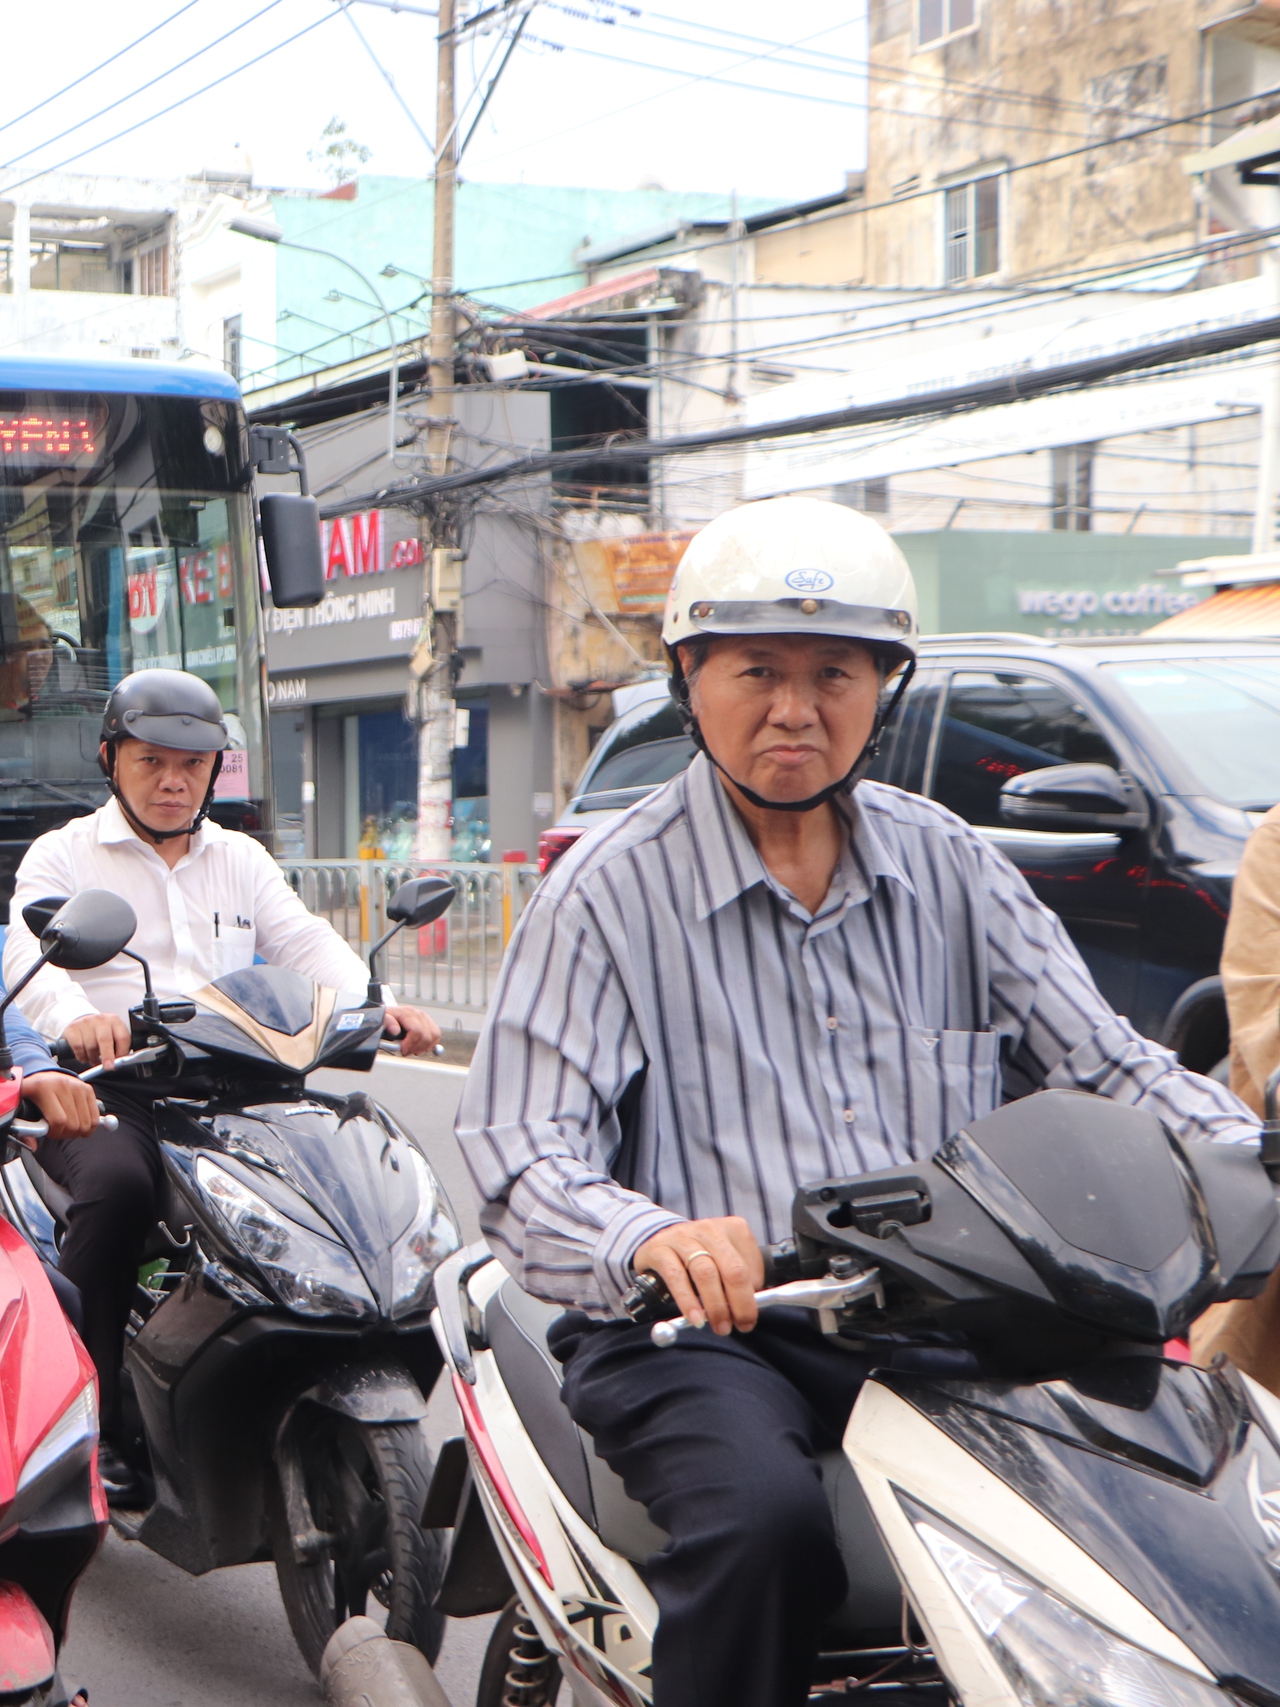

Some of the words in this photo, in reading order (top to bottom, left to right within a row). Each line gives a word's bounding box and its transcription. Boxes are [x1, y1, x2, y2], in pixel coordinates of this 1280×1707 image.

[358, 587, 396, 619] MINH
[1017, 589, 1099, 623] wego
[1103, 583, 1198, 616] coffee
[278, 678, 307, 701] NAM
